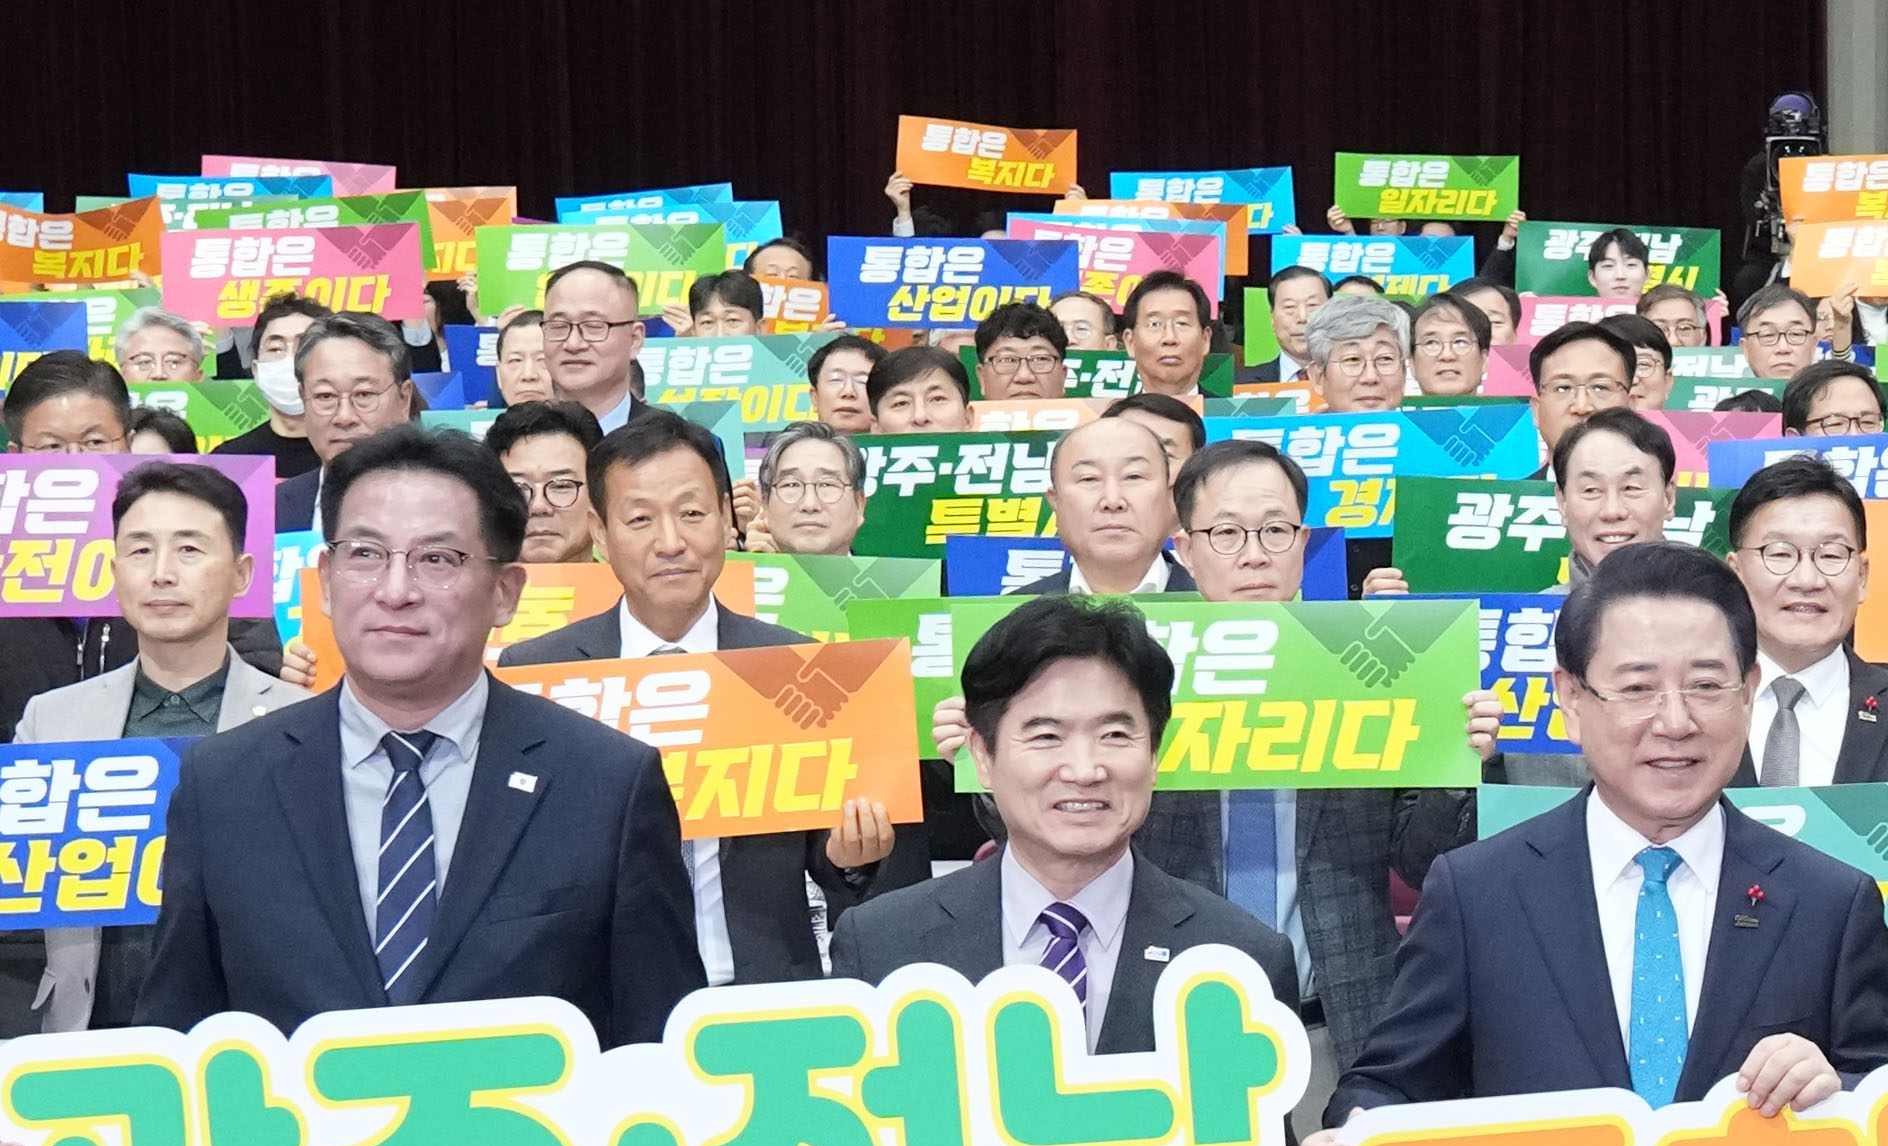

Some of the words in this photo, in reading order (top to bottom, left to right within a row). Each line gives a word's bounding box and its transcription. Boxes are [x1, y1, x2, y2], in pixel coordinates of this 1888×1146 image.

[921, 123, 1008, 158] 통합은
[967, 157, 1056, 188] 복지다
[1134, 177, 1224, 203] 통합은
[1358, 159, 1450, 188] 통합은
[1378, 188, 1497, 216] 일자리다
[32, 242, 145, 280] 복지다
[189, 235, 316, 279] 통합은
[505, 232, 630, 271] 통합은
[860, 245, 985, 285] 통합은
[1296, 242, 1395, 272] 통합은
[762, 283, 823, 322] 합은
[1156, 698, 1421, 774] 자리다
[1, 755, 160, 836] 합은
[665, 737, 859, 822] 지다
